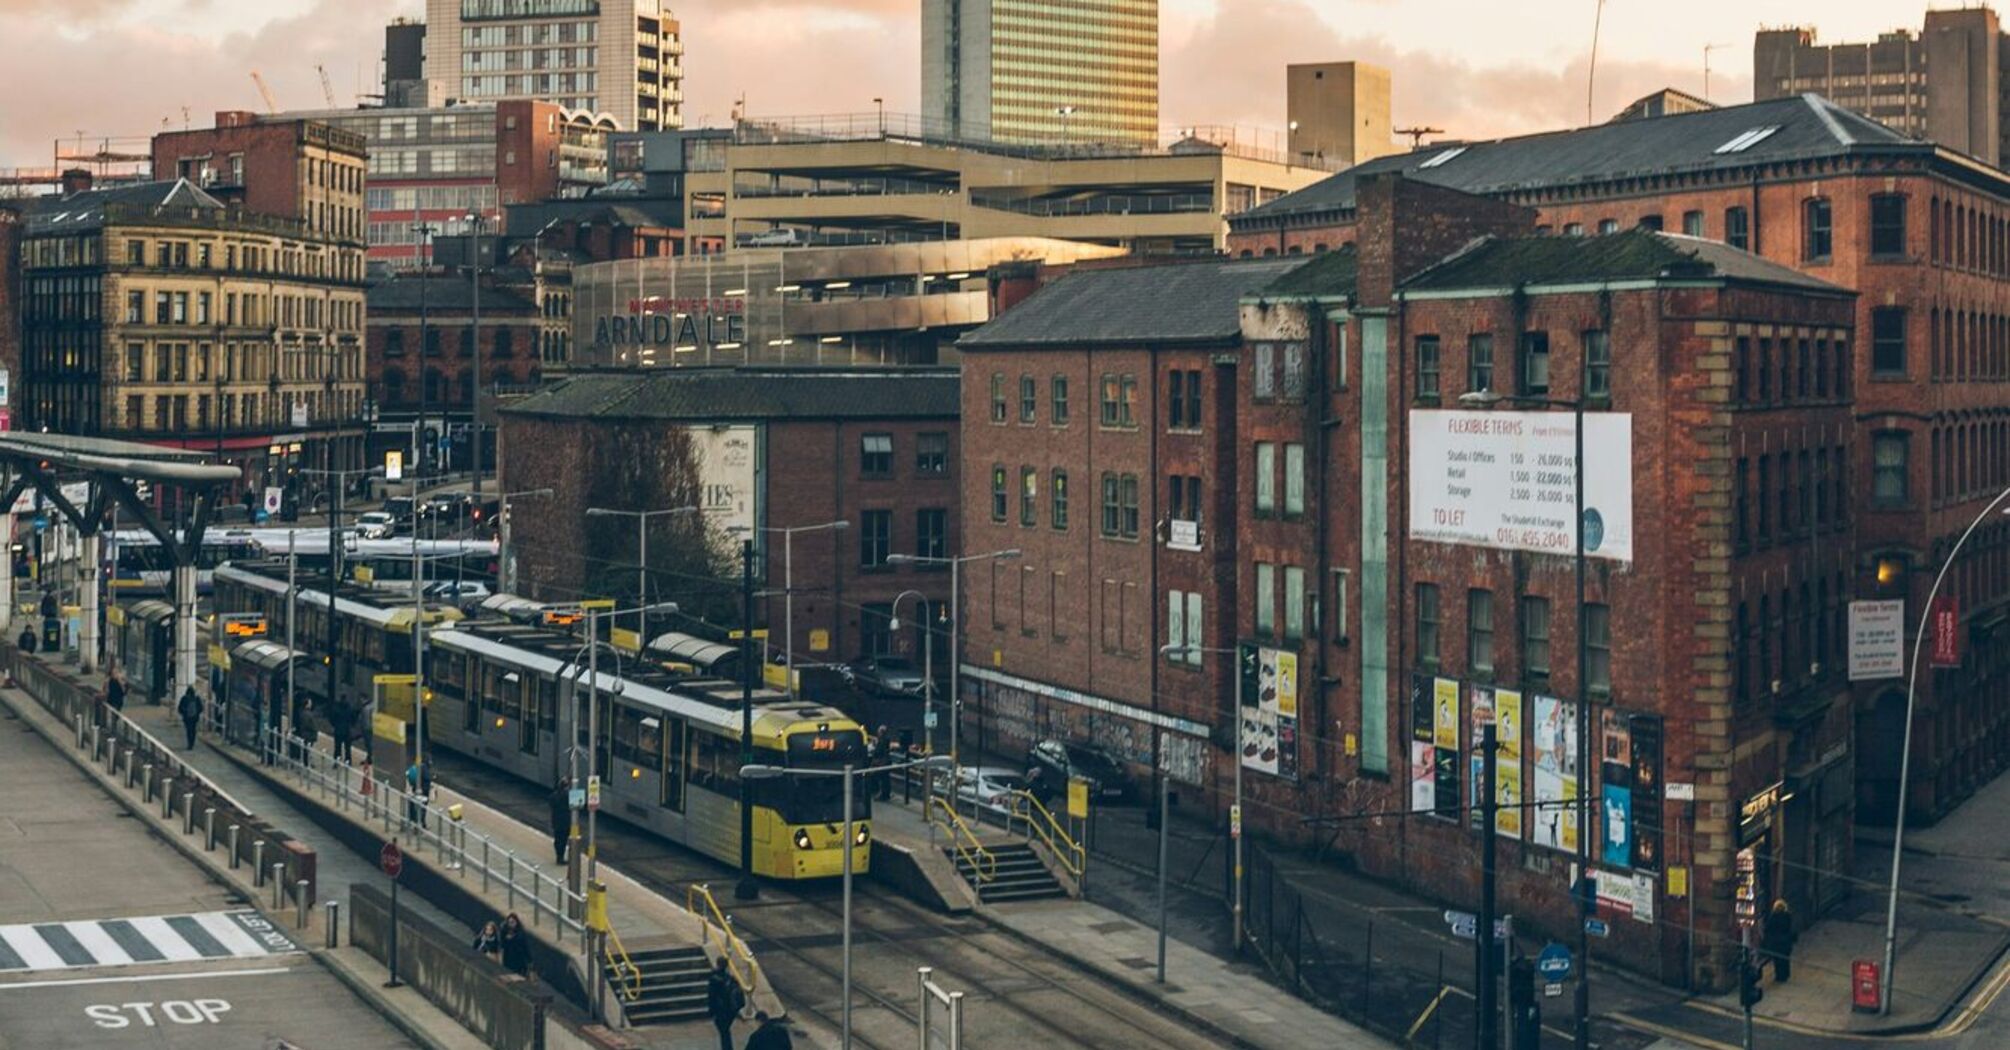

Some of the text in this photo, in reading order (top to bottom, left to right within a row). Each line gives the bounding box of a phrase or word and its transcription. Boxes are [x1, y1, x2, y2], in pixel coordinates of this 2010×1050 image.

[629, 297, 744, 313] MANCHESTER
[595, 314, 744, 345] ARNDALE
[1448, 418, 1523, 436] FLEXIBLE TERMS
[1473, 451, 1495, 464] Offices
[1510, 452, 1524, 465] 150
[1447, 467, 1466, 479] Retail
[1447, 483, 1472, 499] Storage
[1433, 508, 1465, 526] TO LET
[84, 998, 232, 1028] STOP
